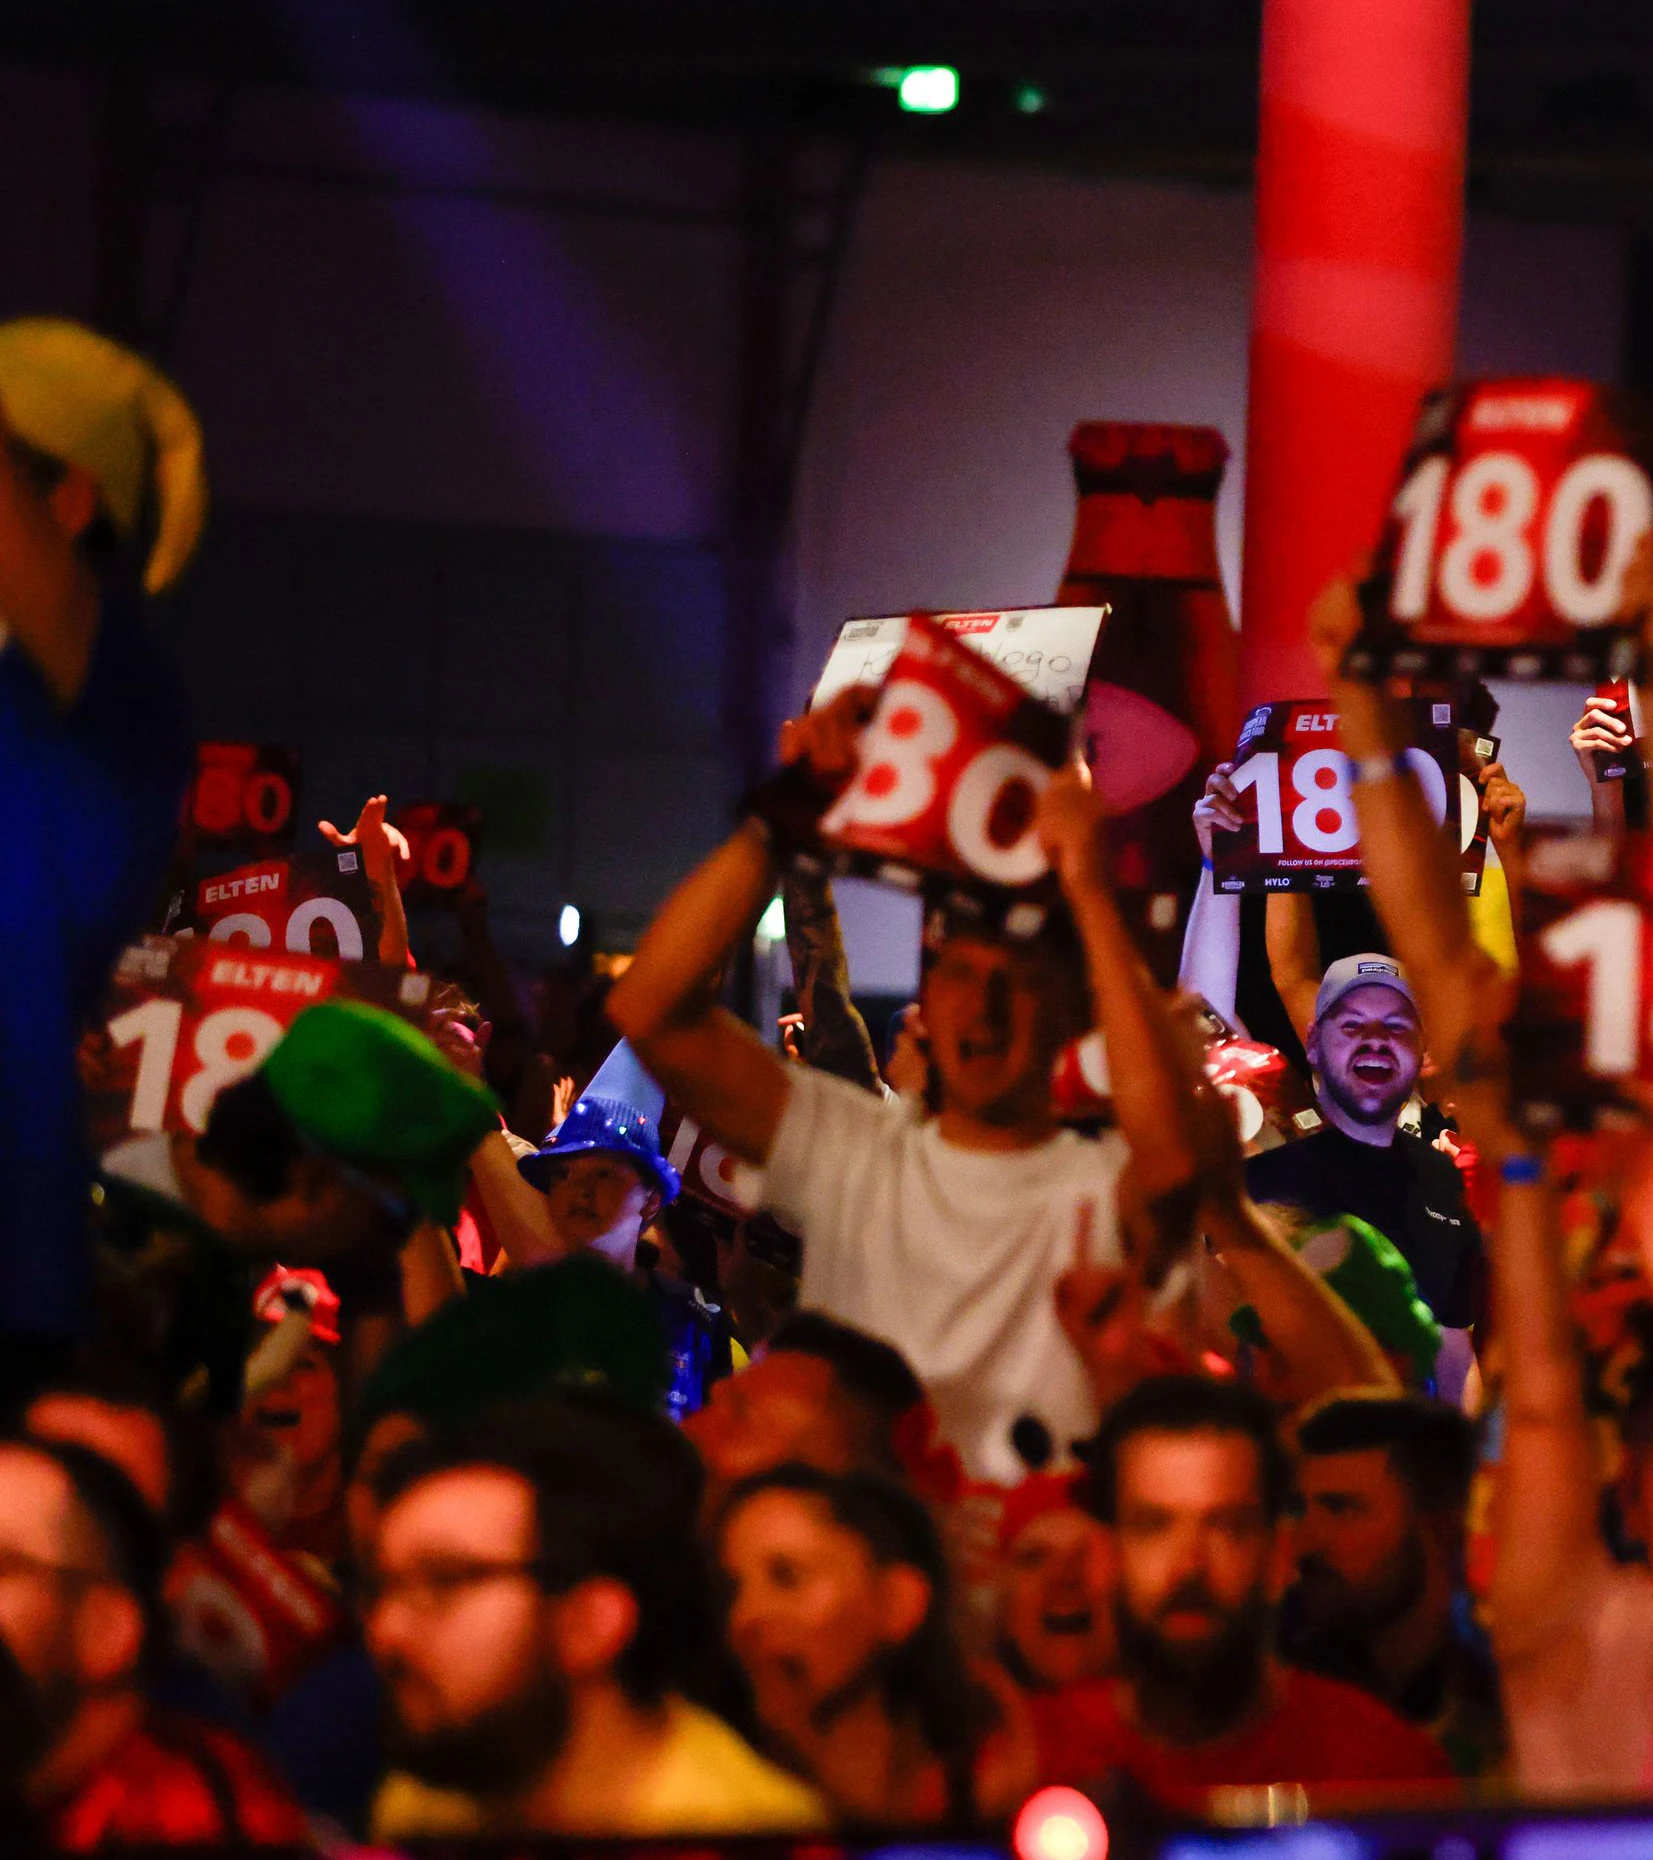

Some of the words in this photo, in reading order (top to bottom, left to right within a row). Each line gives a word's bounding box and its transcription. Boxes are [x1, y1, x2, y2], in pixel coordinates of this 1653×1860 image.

[1295, 714, 1341, 732] ELT
[820, 678, 1053, 887] 80
[205, 873, 281, 904] ELTEN
[1264, 877, 1291, 887] HYLO
[211, 958, 325, 997] ELTEN
[106, 998, 286, 1136] 18
